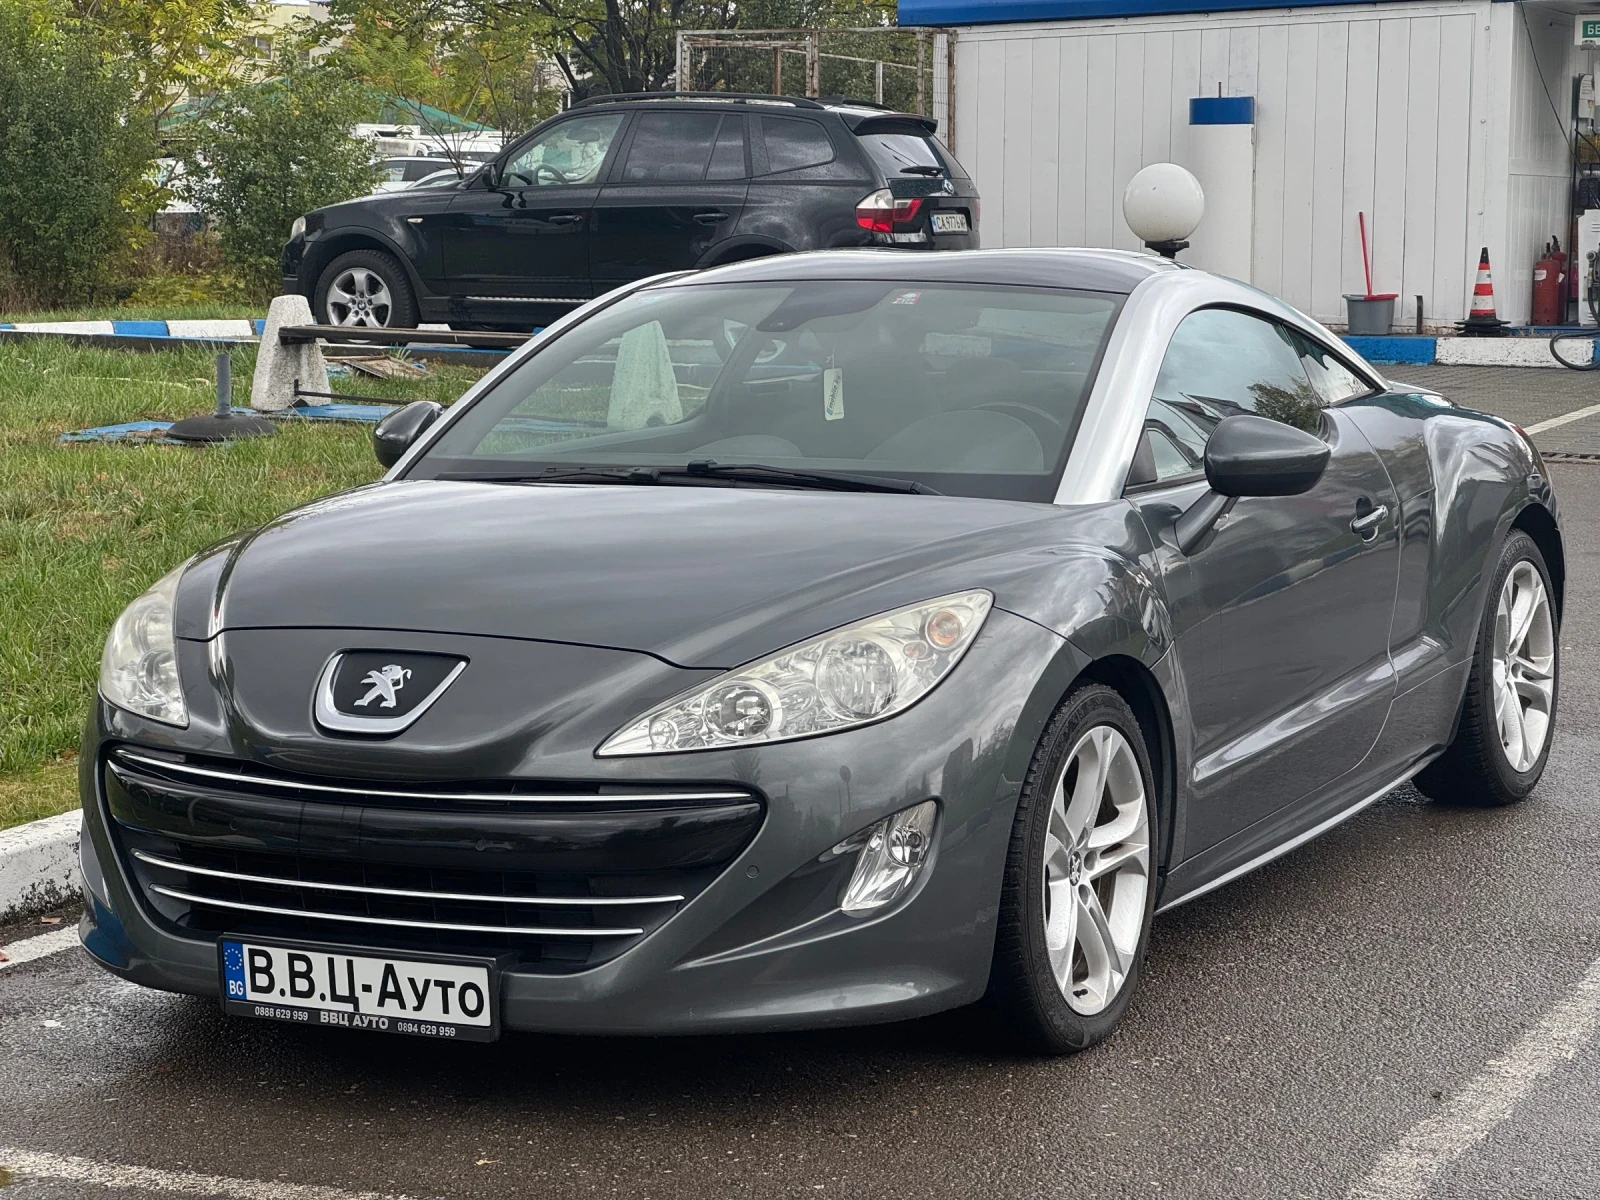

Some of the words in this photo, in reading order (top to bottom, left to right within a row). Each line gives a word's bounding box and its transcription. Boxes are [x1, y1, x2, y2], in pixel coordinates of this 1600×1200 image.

[229, 980, 244, 996] BG
[254, 1006, 275, 1018] 0888
[275, 1008, 291, 1020] 629
[292, 1009, 309, 1021] 959
[319, 1010, 350, 1027] ВВЦ
[352, 1013, 389, 1030] АУТО
[397, 1022, 419, 1033] 0894
[420, 1023, 437, 1035] 629
[438, 1025, 456, 1037] 959
